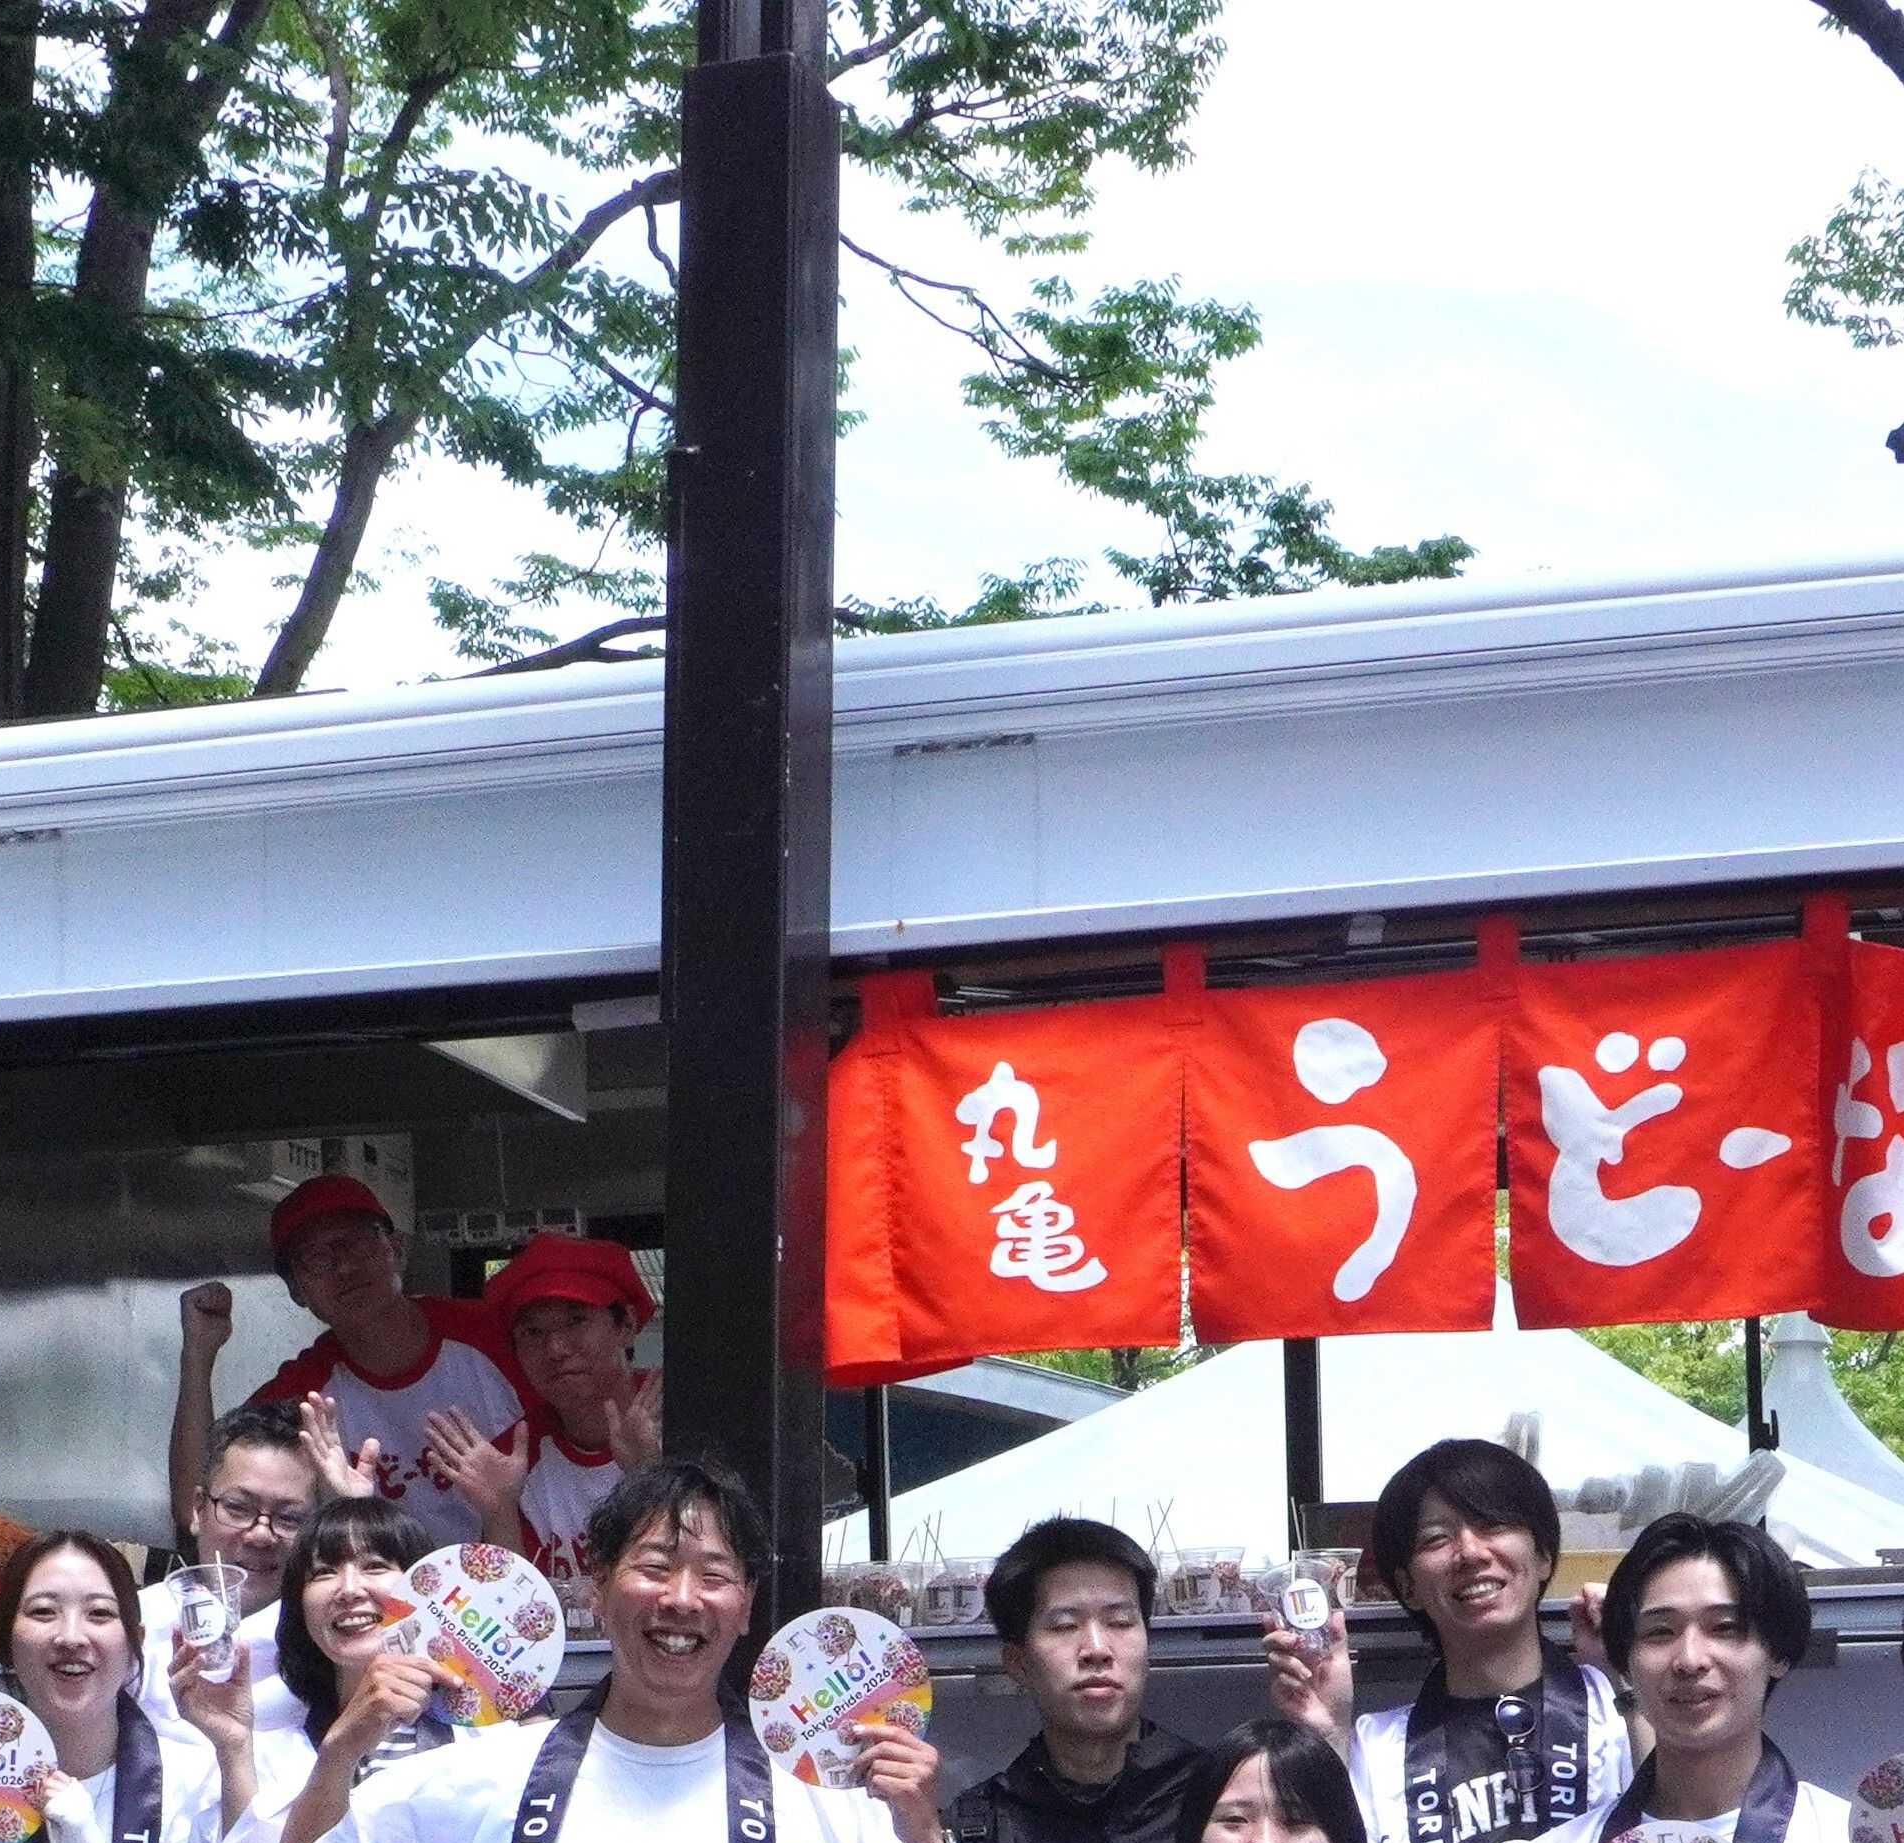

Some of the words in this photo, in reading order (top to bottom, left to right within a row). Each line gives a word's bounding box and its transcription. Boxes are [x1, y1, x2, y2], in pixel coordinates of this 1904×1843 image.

[955, 1060, 1108, 1293] 丸亀
[426, 1601, 455, 1631] Tokyo
[456, 1629, 483, 1656] Pride
[484, 1655, 511, 1682] 2026
[442, 1585, 525, 1665] Hello!
[789, 1650, 875, 1724] Hello!
[800, 1715, 834, 1741] Tokyo
[833, 1690, 863, 1716] Pride
[863, 1668, 891, 1693] 2026
